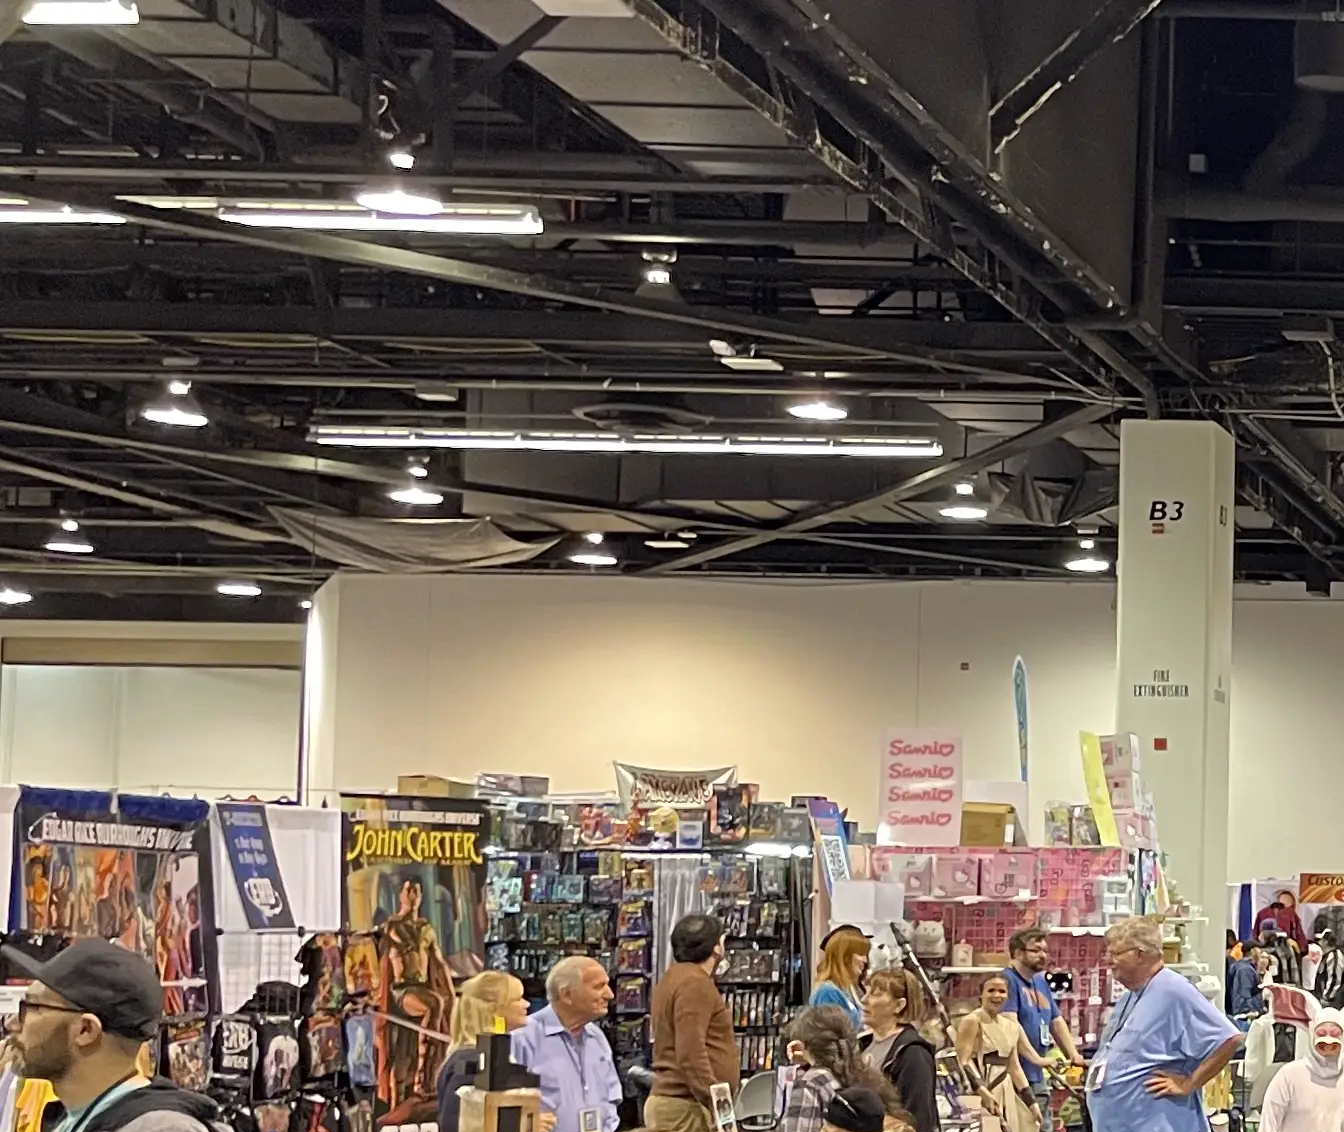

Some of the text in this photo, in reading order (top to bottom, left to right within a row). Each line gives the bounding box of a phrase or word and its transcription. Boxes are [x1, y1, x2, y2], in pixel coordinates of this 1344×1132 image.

[1149, 500, 1185, 521] B3
[1153, 669, 1170, 682] FIRE
[1133, 684, 1190, 697] EXTINGUISHER
[889, 739, 955, 757] Sanrio
[888, 762, 954, 779] Sanrio
[888, 786, 953, 802] Sanrio
[887, 810, 952, 826] Sanrio
[42, 818, 74, 842] EDGAR
[74, 821, 97, 844] RICE
[346, 823, 484, 864] JOHN CARTER
